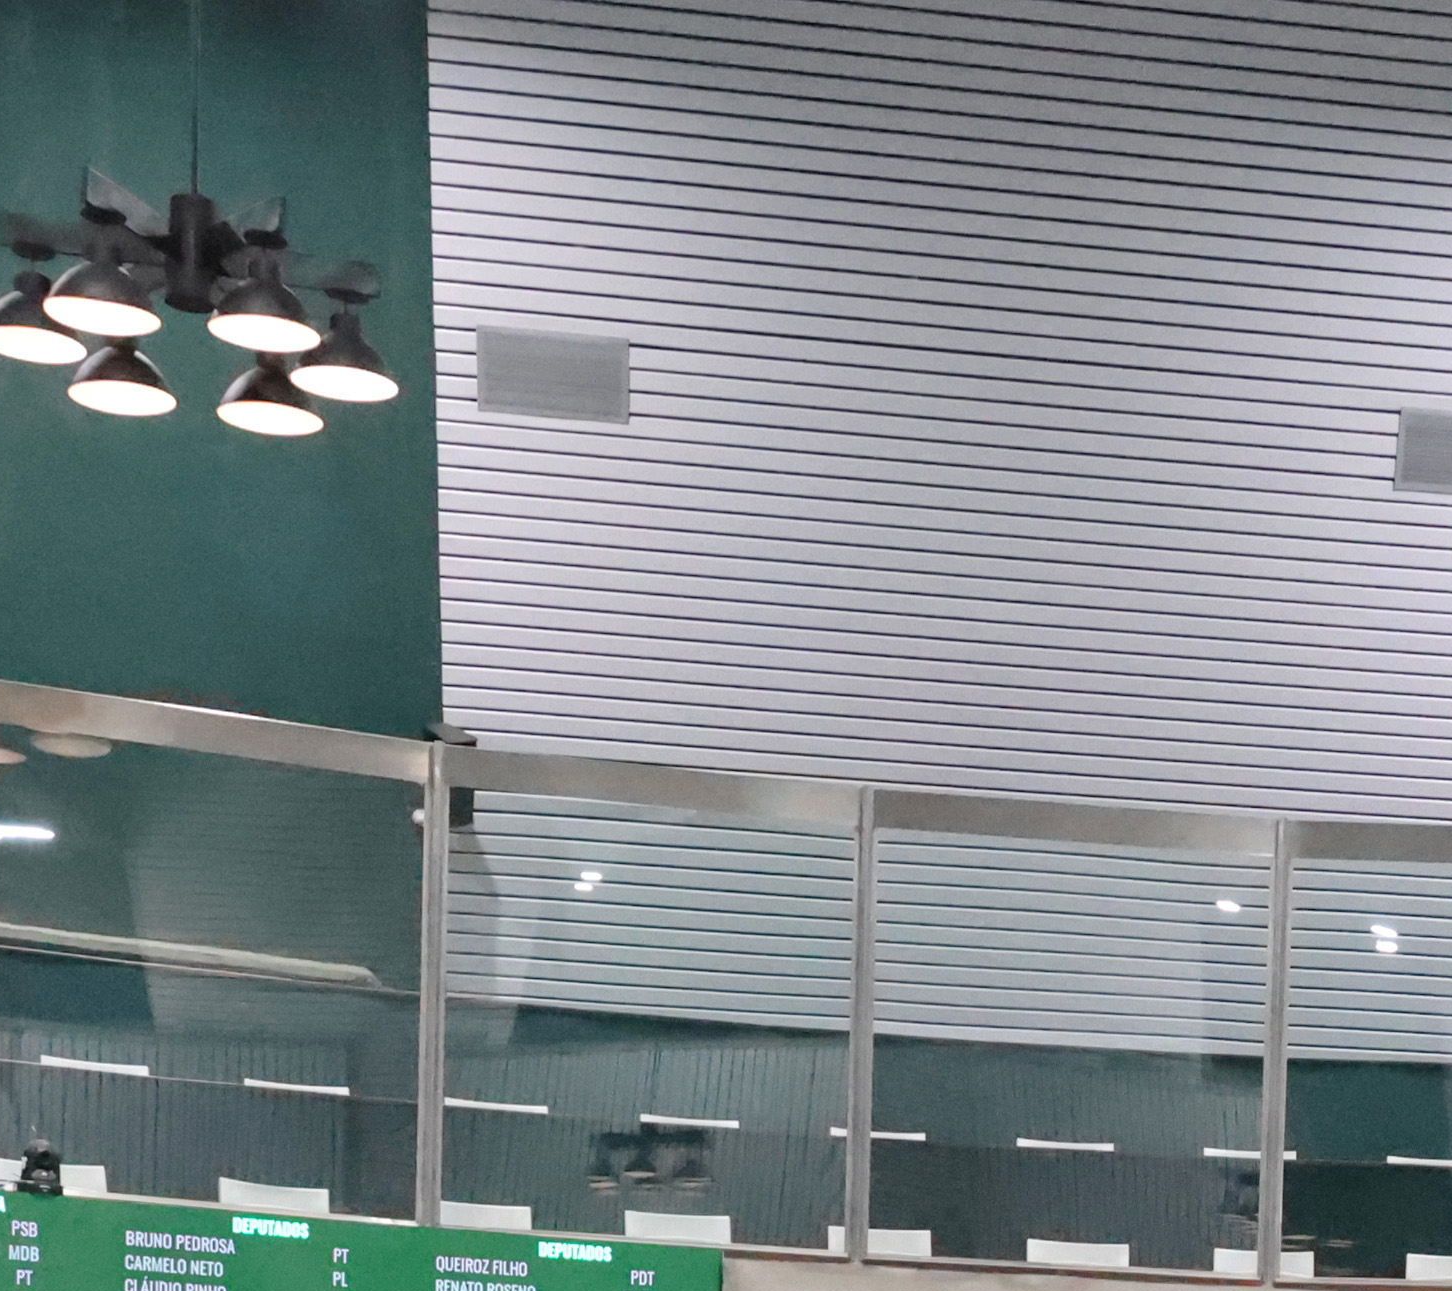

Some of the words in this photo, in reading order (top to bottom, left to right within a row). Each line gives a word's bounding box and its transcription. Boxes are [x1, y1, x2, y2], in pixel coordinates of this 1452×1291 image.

[12, 1220, 38, 1237] PSB
[232, 1217, 309, 1238] DEPUTADOS
[126, 1230, 172, 1249] BRUNO
[176, 1235, 235, 1254] PEDROSA
[9, 1245, 39, 1262] MDB
[333, 1248, 349, 1263] PT
[539, 1242, 612, 1261] DEPUTADOS
[125, 1254, 187, 1274] CARMELO
[190, 1260, 223, 1277] NETO
[436, 1256, 489, 1274] QUEIROZ
[492, 1260, 528, 1277] FILHO
[16, 1269, 33, 1285] PT
[333, 1271, 348, 1287] PL
[631, 1270, 655, 1285] PDT
